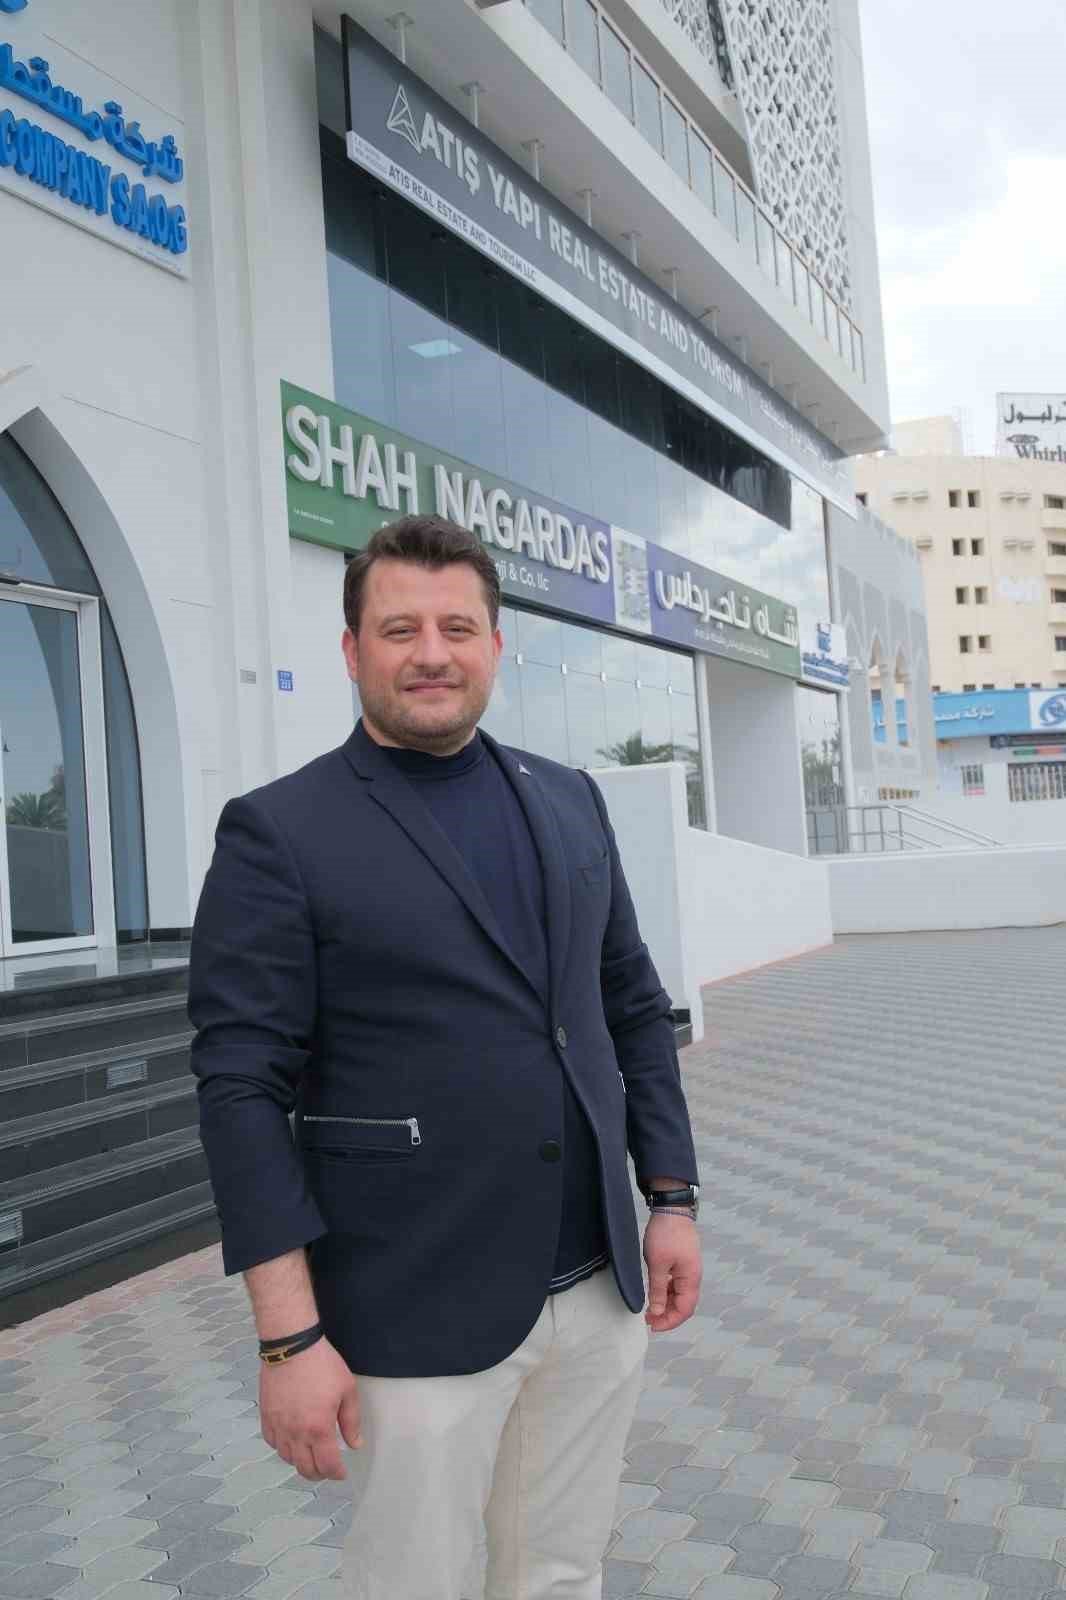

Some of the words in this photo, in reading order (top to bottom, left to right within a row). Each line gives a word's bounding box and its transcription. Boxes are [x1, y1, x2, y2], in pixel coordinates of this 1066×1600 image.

[0, 108, 111, 216] COMPANY
[103, 100, 184, 185] شركة
[411, 182, 434, 209] REAL
[488, 164, 542, 240] YAPI
[548, 215, 596, 281] REAL
[599, 256, 656, 330] ESTATE
[660, 309, 689, 353] AND
[691, 334, 744, 400] TOURISM
[285, 404, 420, 516] SHAH
[433, 463, 611, 584] NAGARDAS
[509, 562, 519, 582] &
